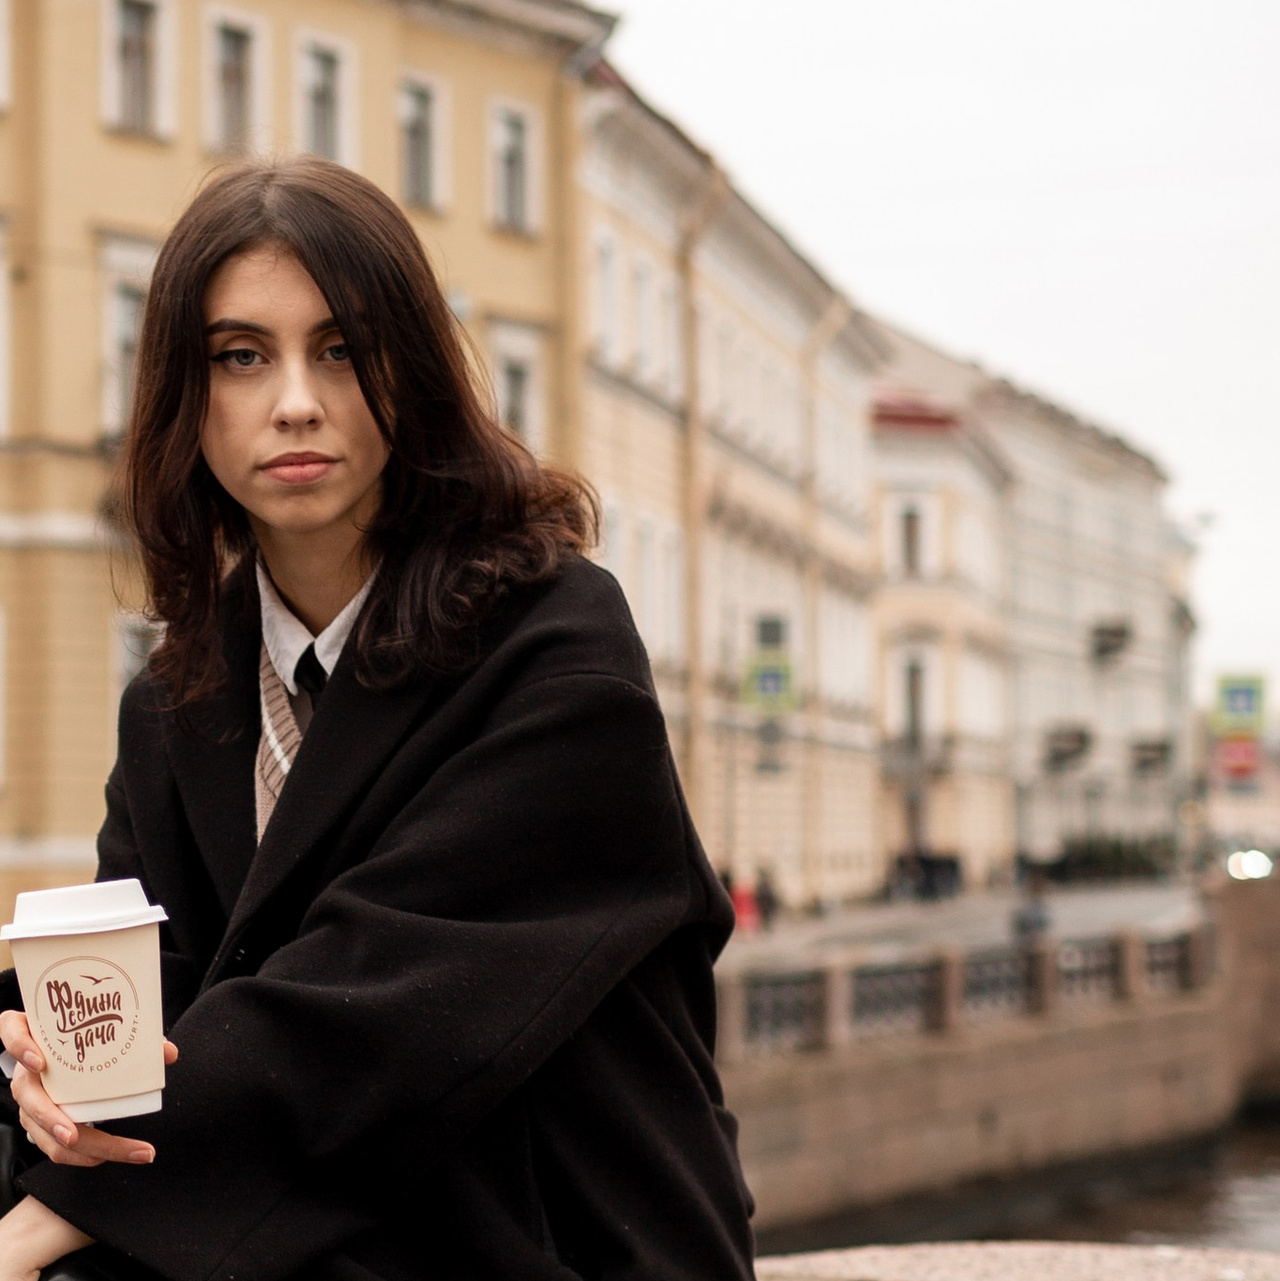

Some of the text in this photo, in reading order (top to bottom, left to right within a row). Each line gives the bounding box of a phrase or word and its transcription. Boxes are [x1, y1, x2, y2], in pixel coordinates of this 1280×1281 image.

[46, 980, 122, 1032] Федина
[40, 1020, 139, 1073] СЕМЕЙНЫЙ FOOD COURT
[74, 1023, 115, 1063] дача
